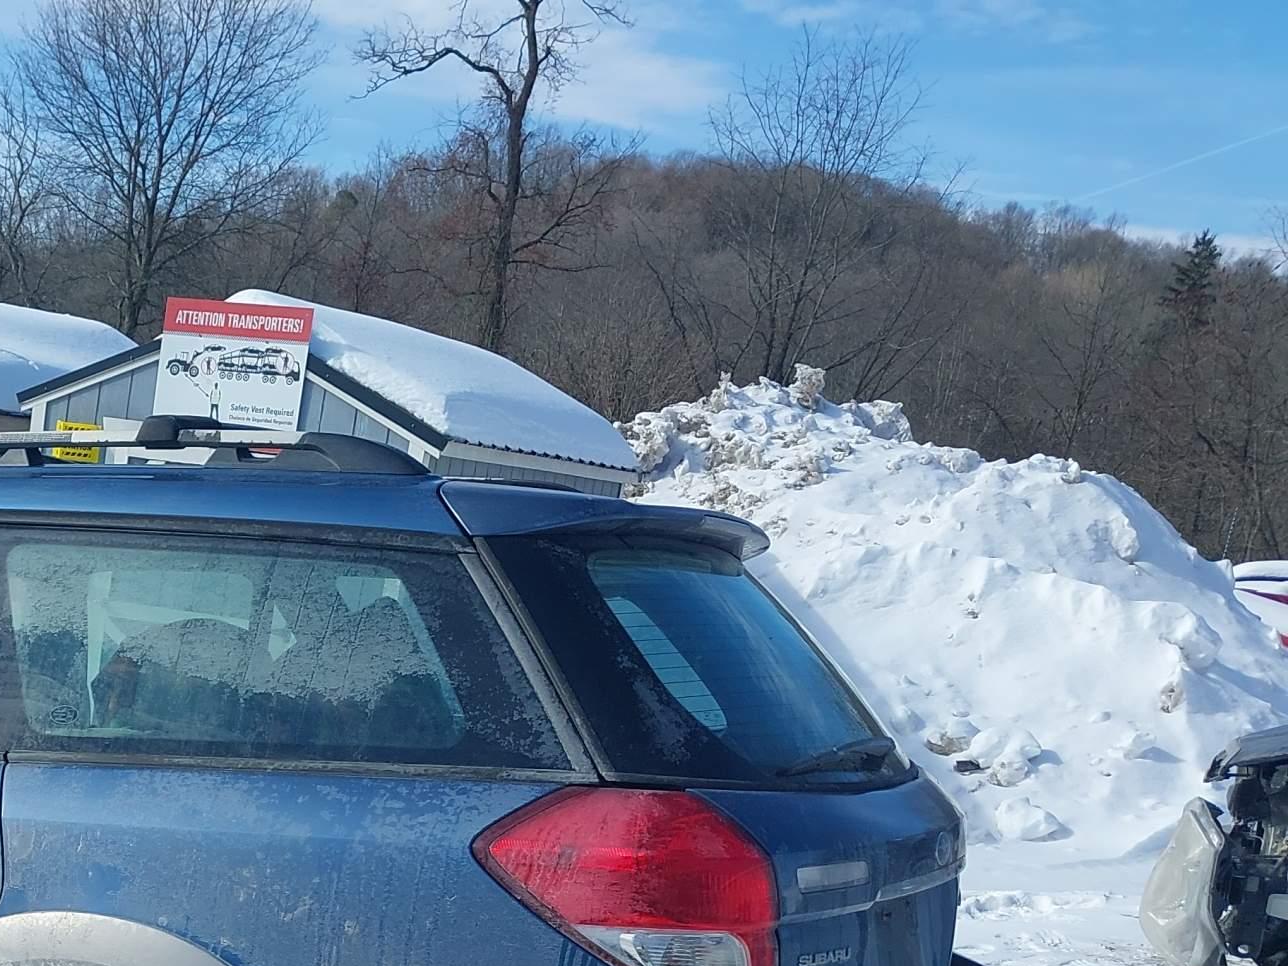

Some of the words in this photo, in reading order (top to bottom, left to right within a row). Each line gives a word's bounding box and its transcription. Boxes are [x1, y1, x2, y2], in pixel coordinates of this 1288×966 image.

[175, 310, 225, 327] ATTENTION
[227, 313, 303, 333] TRANSPORTERS!
[230, 403, 250, 414] Safety
[251, 405, 264, 414] Vest
[265, 407, 294, 417] Required
